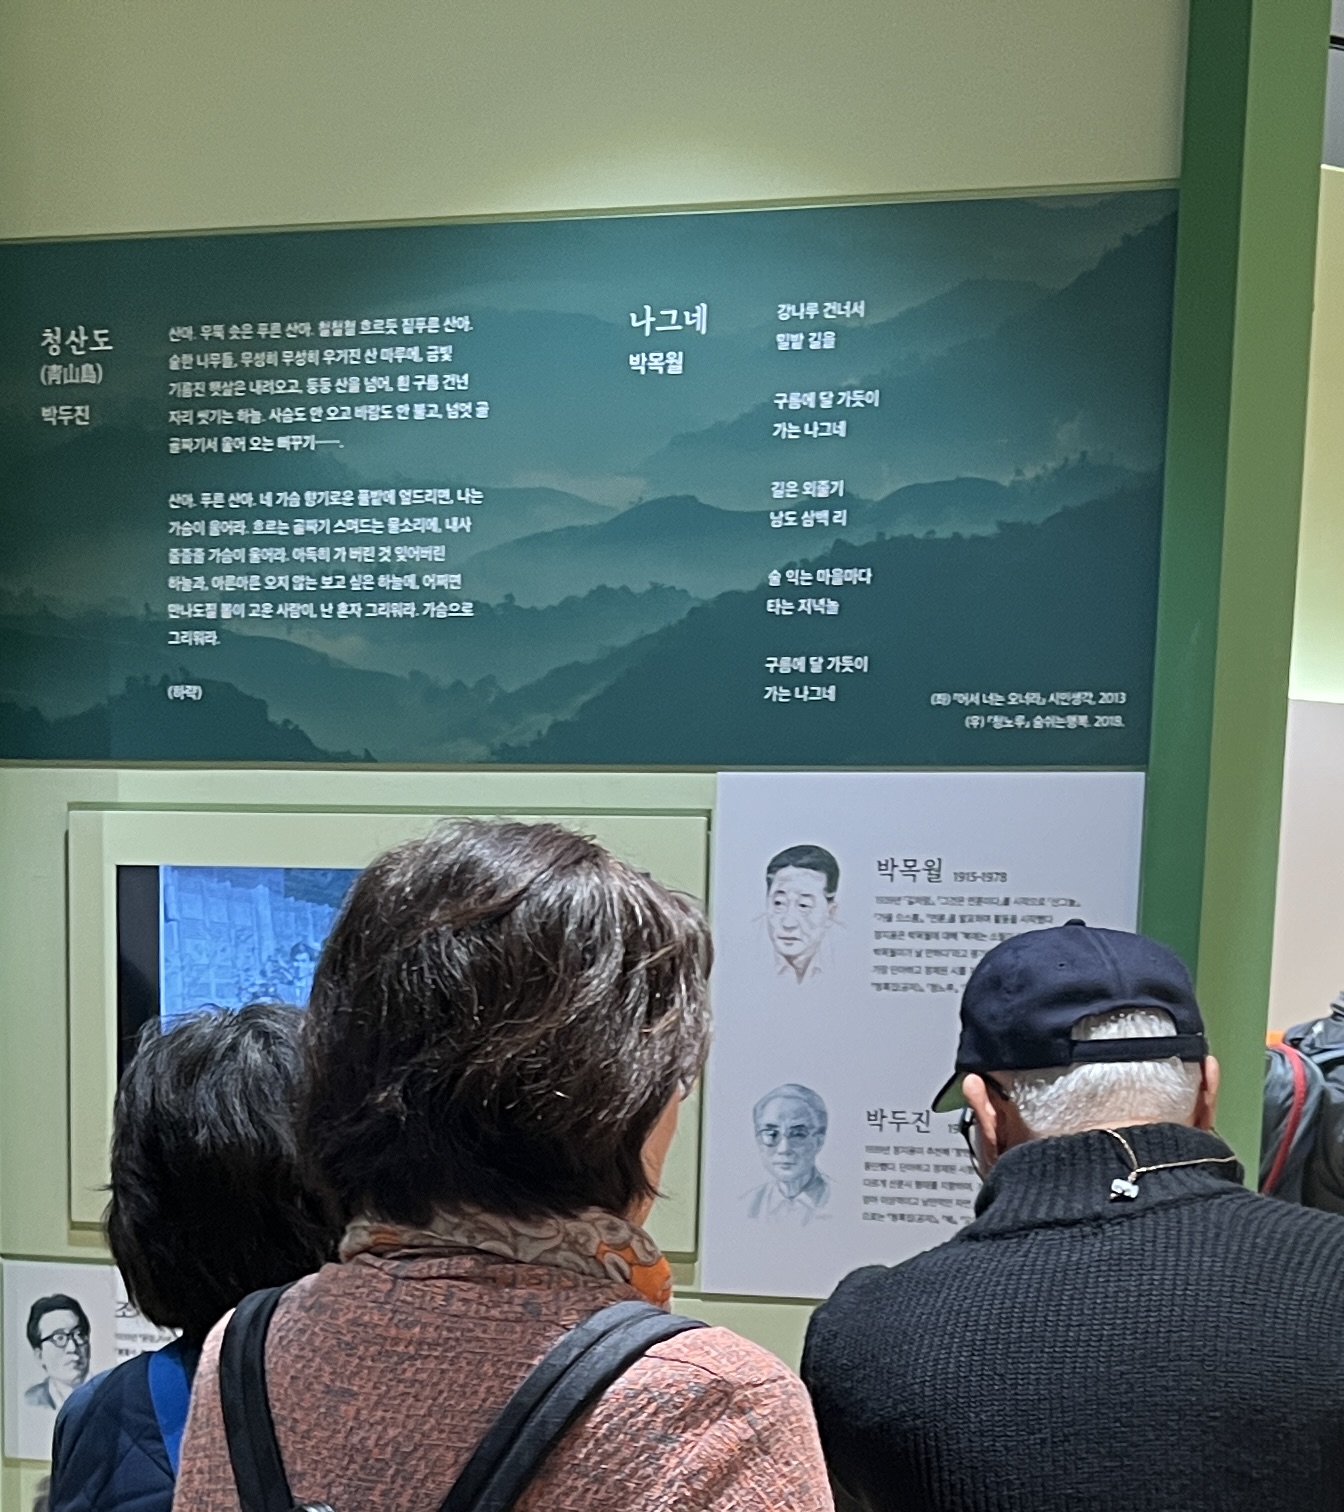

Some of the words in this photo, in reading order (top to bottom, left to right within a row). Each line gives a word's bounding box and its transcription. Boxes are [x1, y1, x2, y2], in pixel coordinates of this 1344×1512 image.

[629, 302, 708, 337] 나그네
[777, 303, 819, 320] 강나루
[823, 301, 865, 318] 건너서
[41, 326, 113, 356] 청산도
[776, 333, 804, 350] 밀밭
[808, 331, 836, 349] 길을
[629, 351, 684, 375] 박목월
[775, 392, 816, 409] 구름에
[819, 391, 834, 408] 달
[837, 390, 880, 408] 가듯이
[41, 405, 90, 425] 박두진
[773, 422, 801, 439] 가는
[803, 421, 847, 437] 나그네
[771, 481, 798, 498] 길은
[802, 480, 844, 497] 외줄기
[769, 512, 797, 527] 남도
[801, 510, 830, 527] 삼백
[832, 510, 847, 525] 리
[768, 569, 781, 585] 술
[785, 570, 813, 585] 익는
[816, 568, 872, 585] 마을마다
[766, 599, 794, 614] 타는
[798, 599, 839, 614] 저녁놀
[766, 657, 806, 673] 구름에
[809, 656, 824, 673] 달
[827, 656, 869, 672] 가듯이
[764, 686, 791, 701] 가는
[794, 686, 836, 701] 나그네
[877, 857, 943, 883] 박목월
[866, 1108, 931, 1134] 박두진
